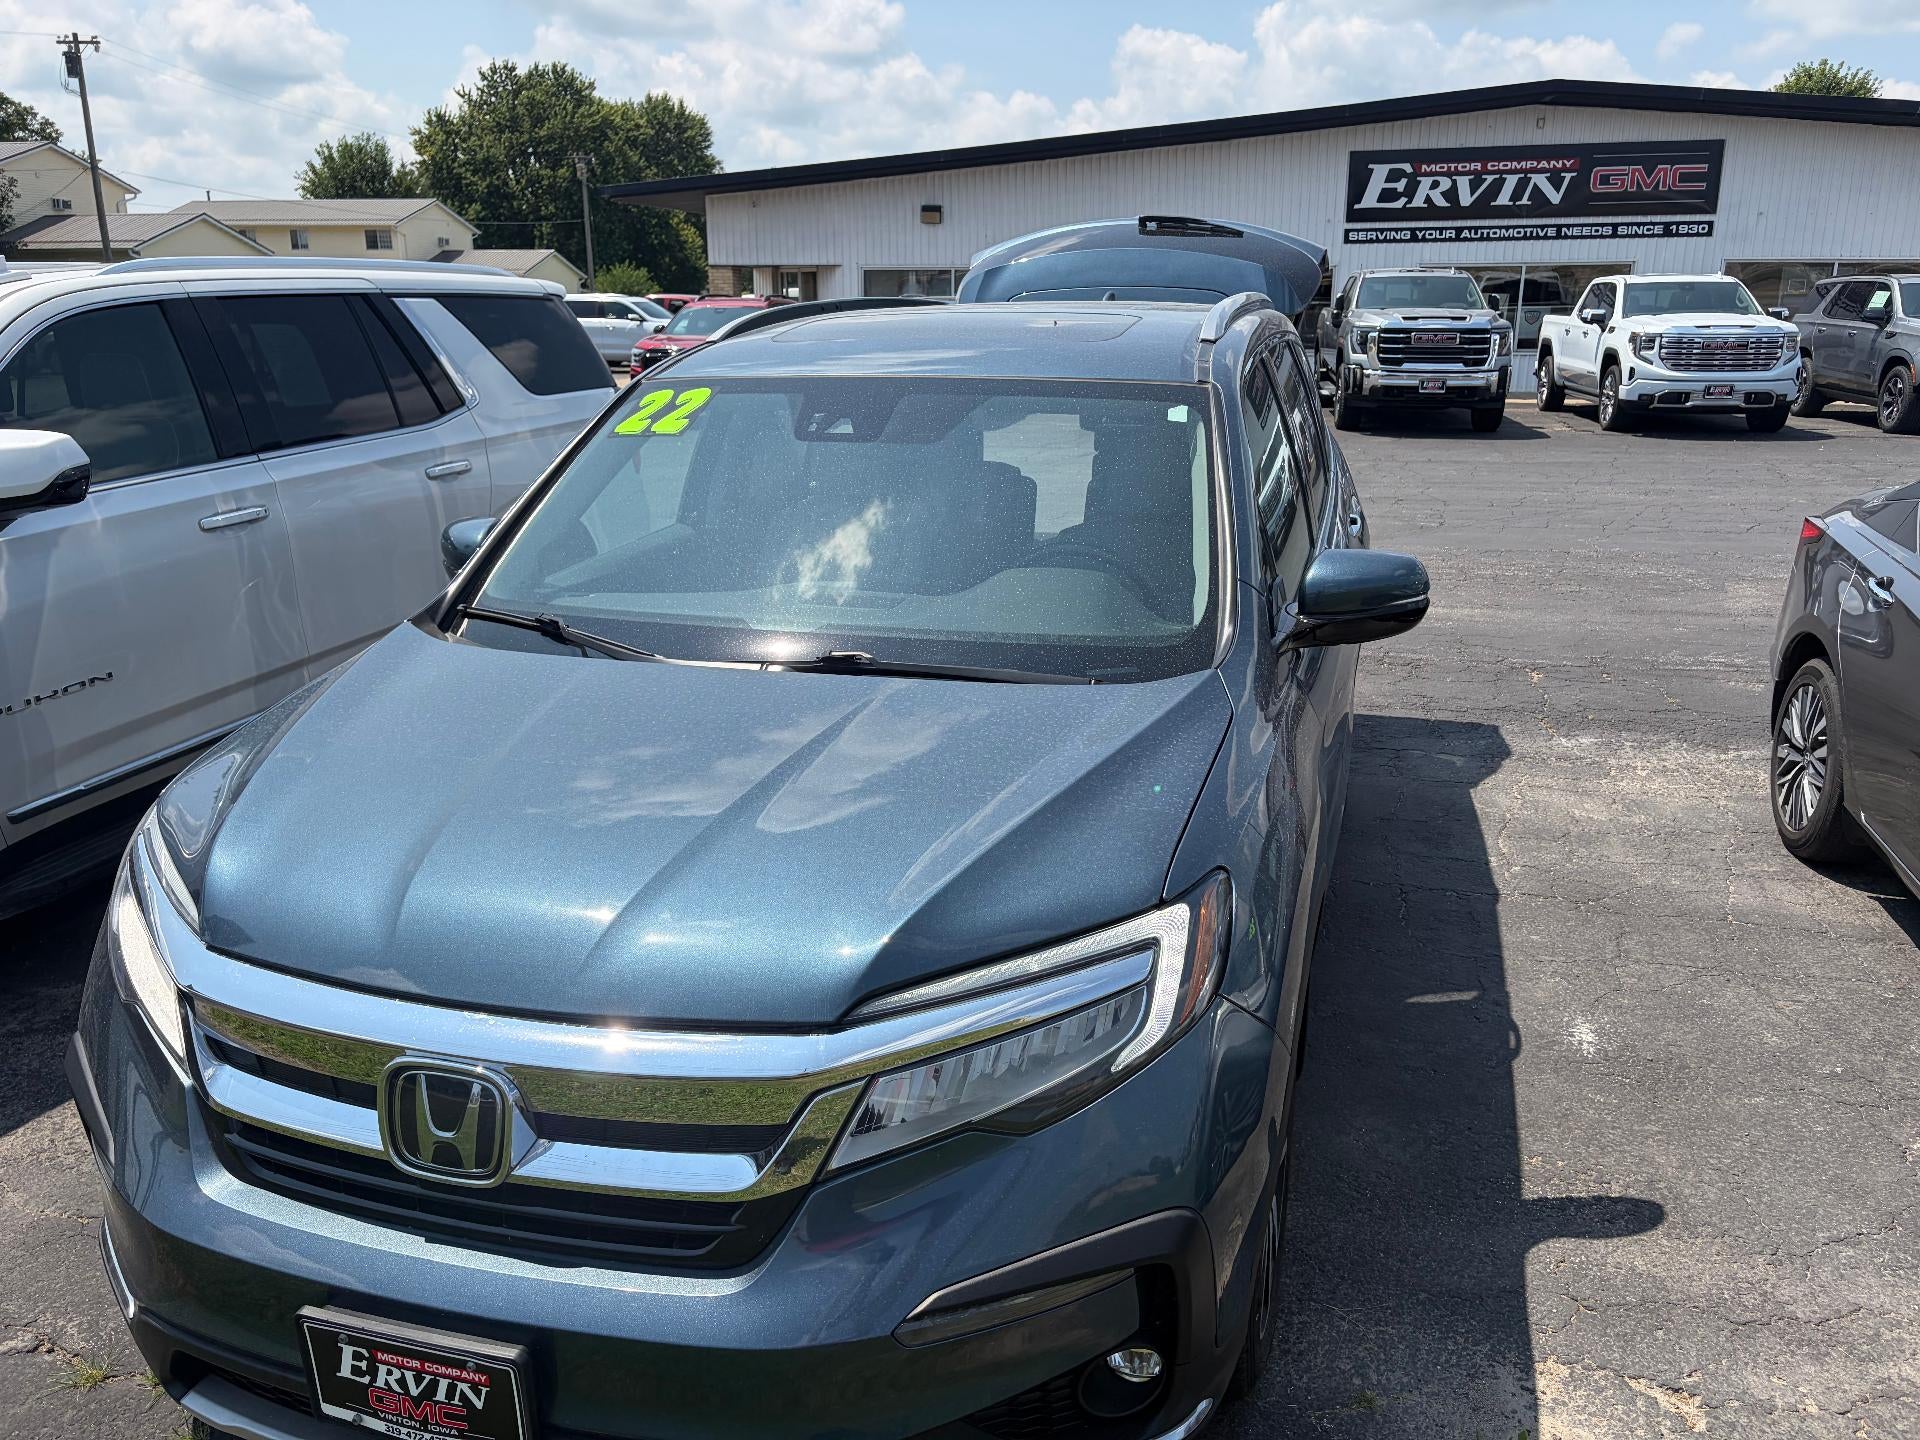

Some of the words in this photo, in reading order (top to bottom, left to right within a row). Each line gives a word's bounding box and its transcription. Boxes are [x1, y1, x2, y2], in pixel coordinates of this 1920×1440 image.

[1421, 162, 1482, 173] MOTOR
[1487, 159, 1575, 171] COMPANY
[1590, 164, 1708, 193] GMC
[1353, 163, 1577, 209] ERVIN
[1348, 230, 1411, 241] SERVING
[1416, 230, 1456, 240] YOUR
[1460, 227, 1557, 239] AUTOMOTIVE
[1561, 226, 1613, 236] NEEDS
[1617, 225, 1664, 235] SINCE
[1669, 224, 1709, 234] 1930
[1703, 341, 1748, 350] GMC
[614, 387, 712, 435] 22
[0, 671, 114, 716] UKON
[336, 1342, 490, 1410] ERVIN
[377, 1352, 421, 1370] MOTOR
[424, 1363, 487, 1384] COMPANY
[368, 1387, 468, 1430] GMC
[427, 1424, 459, 1436] IOWA
